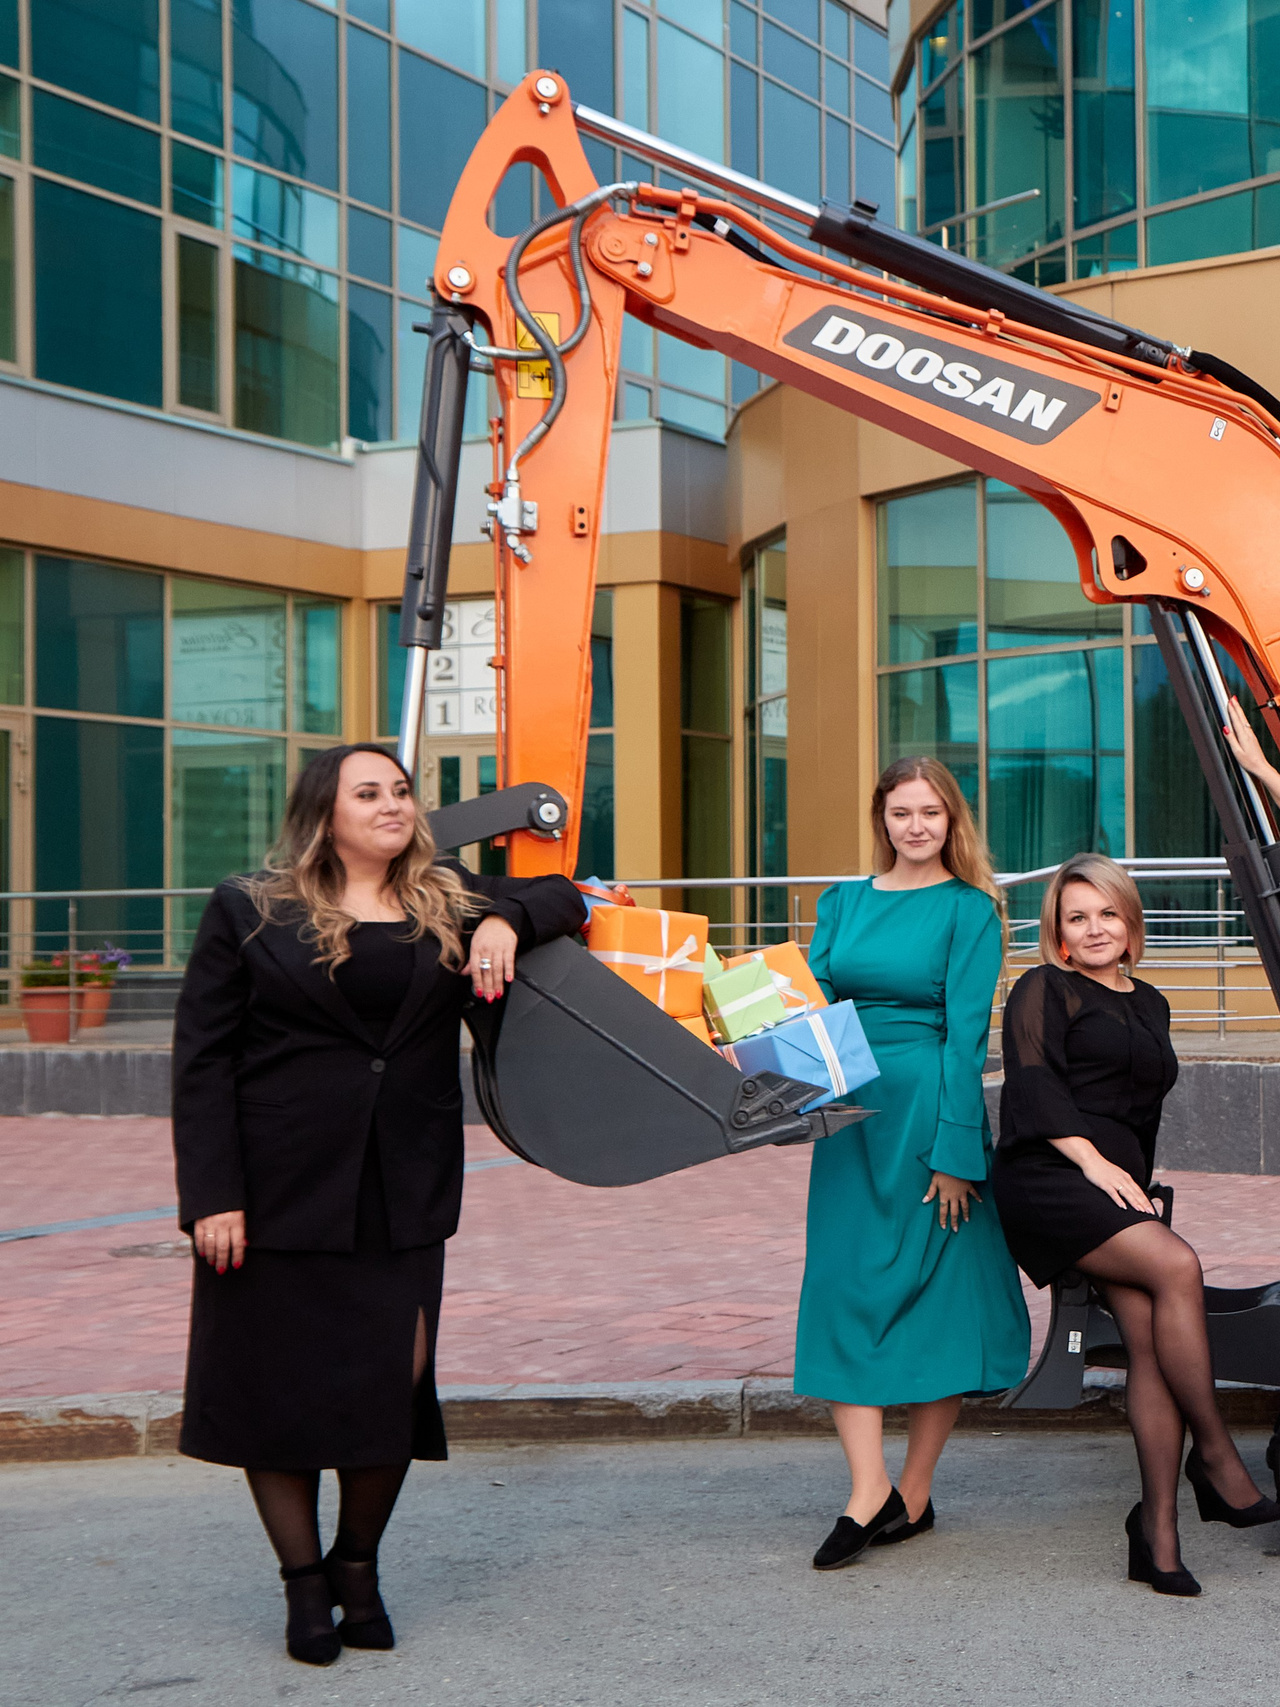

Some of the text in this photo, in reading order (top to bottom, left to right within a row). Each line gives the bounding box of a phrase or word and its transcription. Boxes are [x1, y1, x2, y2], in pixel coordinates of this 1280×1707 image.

[811, 315, 1067, 431] DOOSAN
[434, 656, 453, 681] 2
[436, 701, 451, 726] 1
